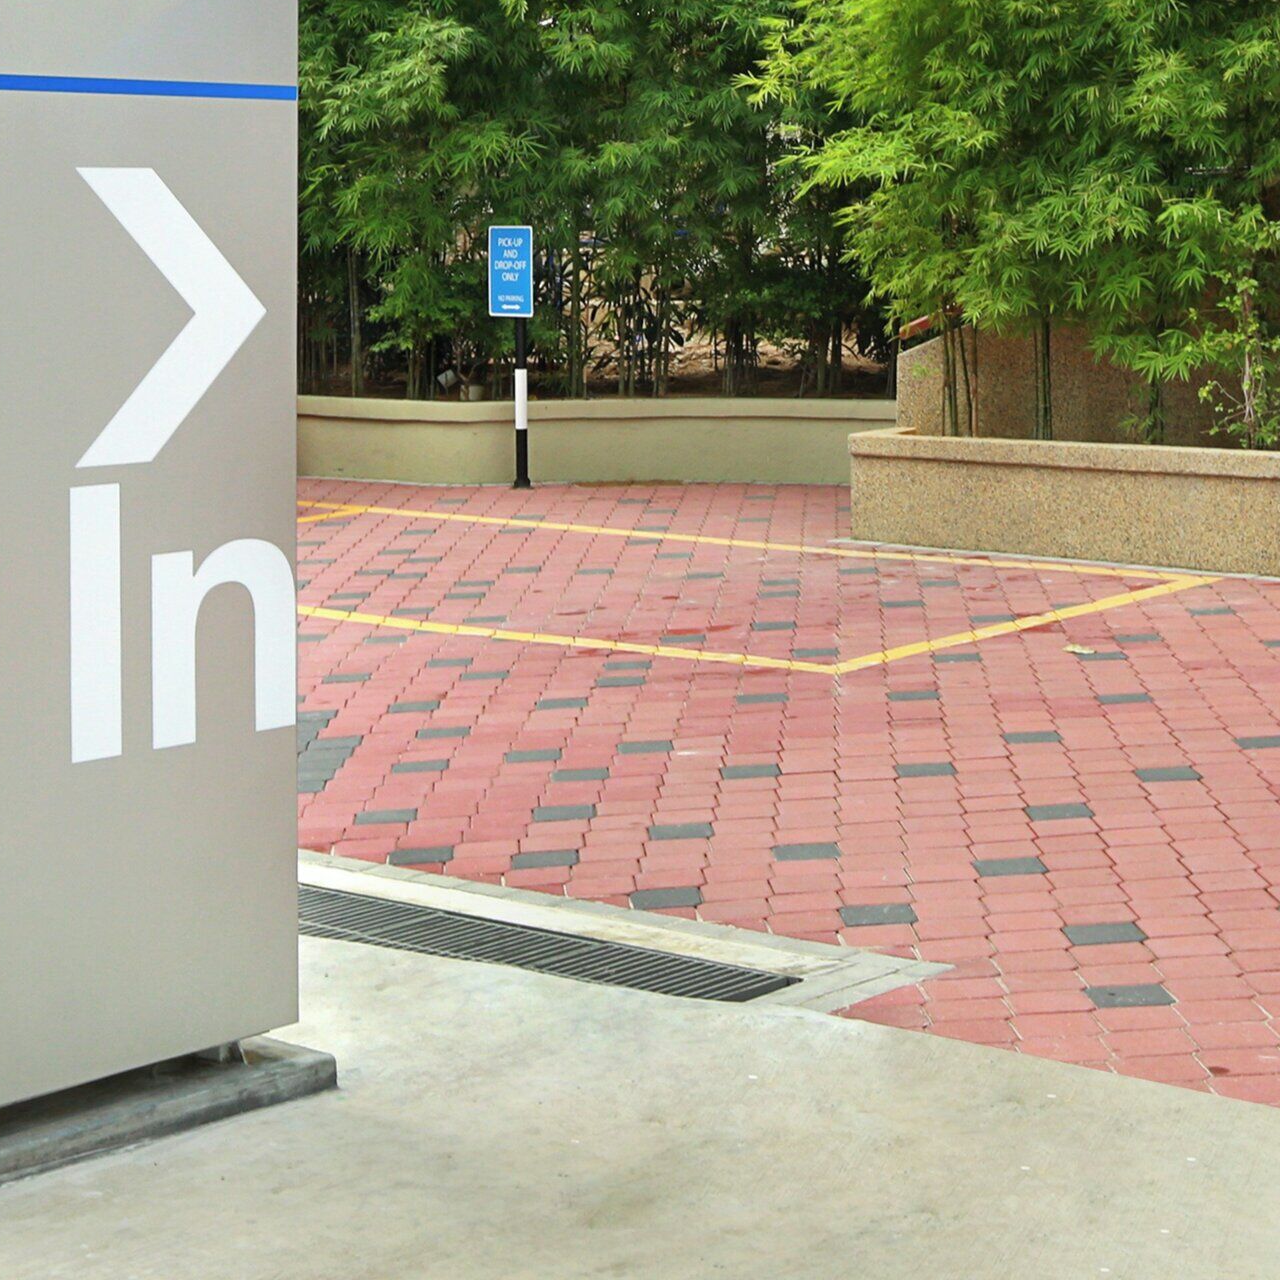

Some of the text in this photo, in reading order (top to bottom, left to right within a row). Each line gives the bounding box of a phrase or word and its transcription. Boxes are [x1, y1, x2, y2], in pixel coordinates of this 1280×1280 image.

[498, 238, 523, 247] PICK-UP
[503, 250, 518, 258] AND
[494, 260, 526, 270] DROP-OFF
[502, 272, 519, 281] ONLY
[69, 482, 296, 763] In
